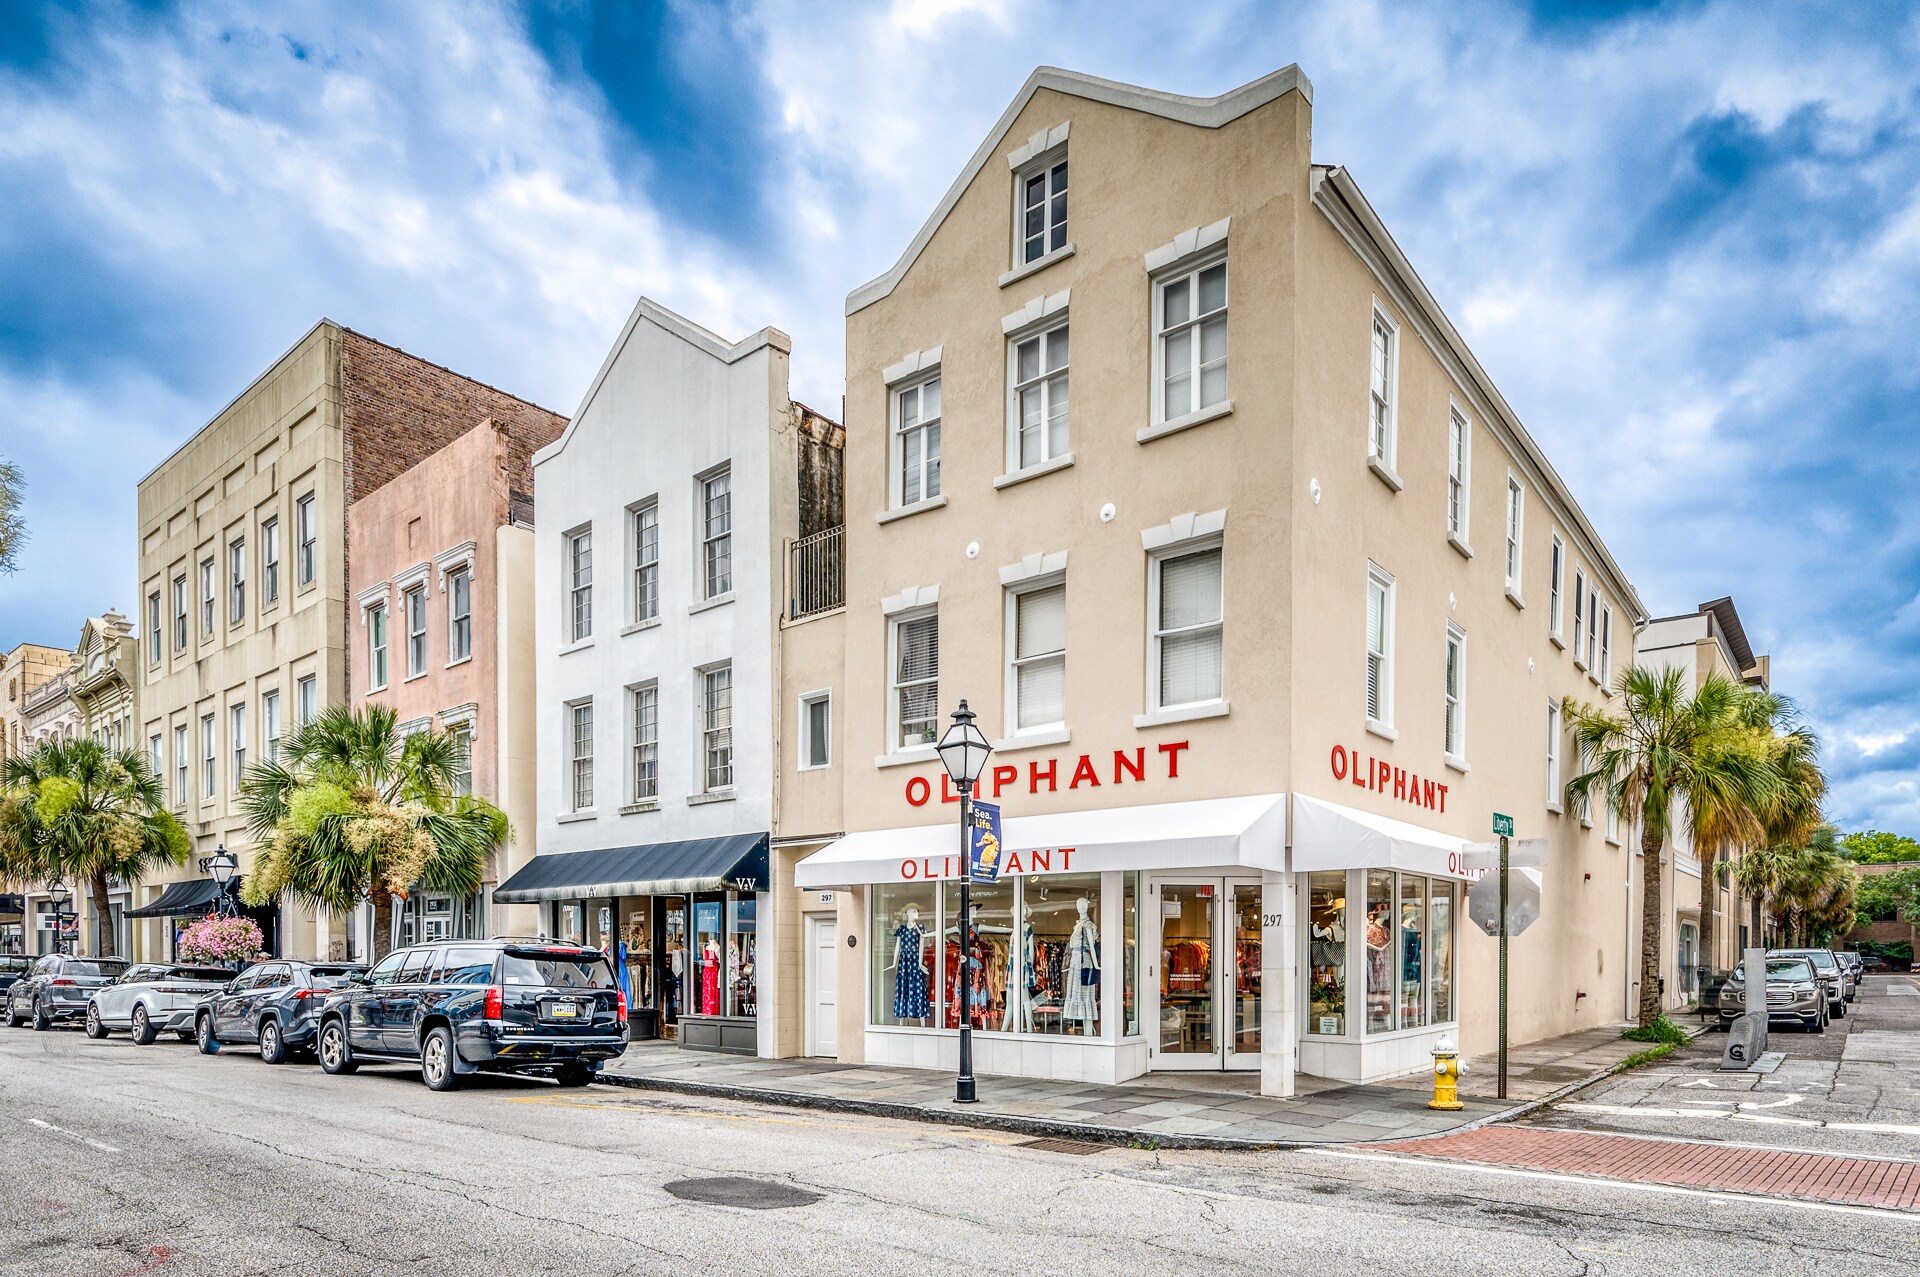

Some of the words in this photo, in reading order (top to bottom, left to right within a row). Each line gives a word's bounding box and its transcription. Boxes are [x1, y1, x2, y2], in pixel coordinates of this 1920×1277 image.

[905, 740, 1189, 806] OLIPHANT
[1331, 744, 1448, 813] OLIPHANT
[974, 808, 993, 820] Sea.
[975, 818, 993, 831] Life.
[1493, 815, 1508, 835] Liberty
[901, 848, 1076, 879] OLIANT
[821, 894, 832, 902] 297
[1263, 914, 1282, 927] 297
[950, 1008, 1005, 1019] OLPHANT
